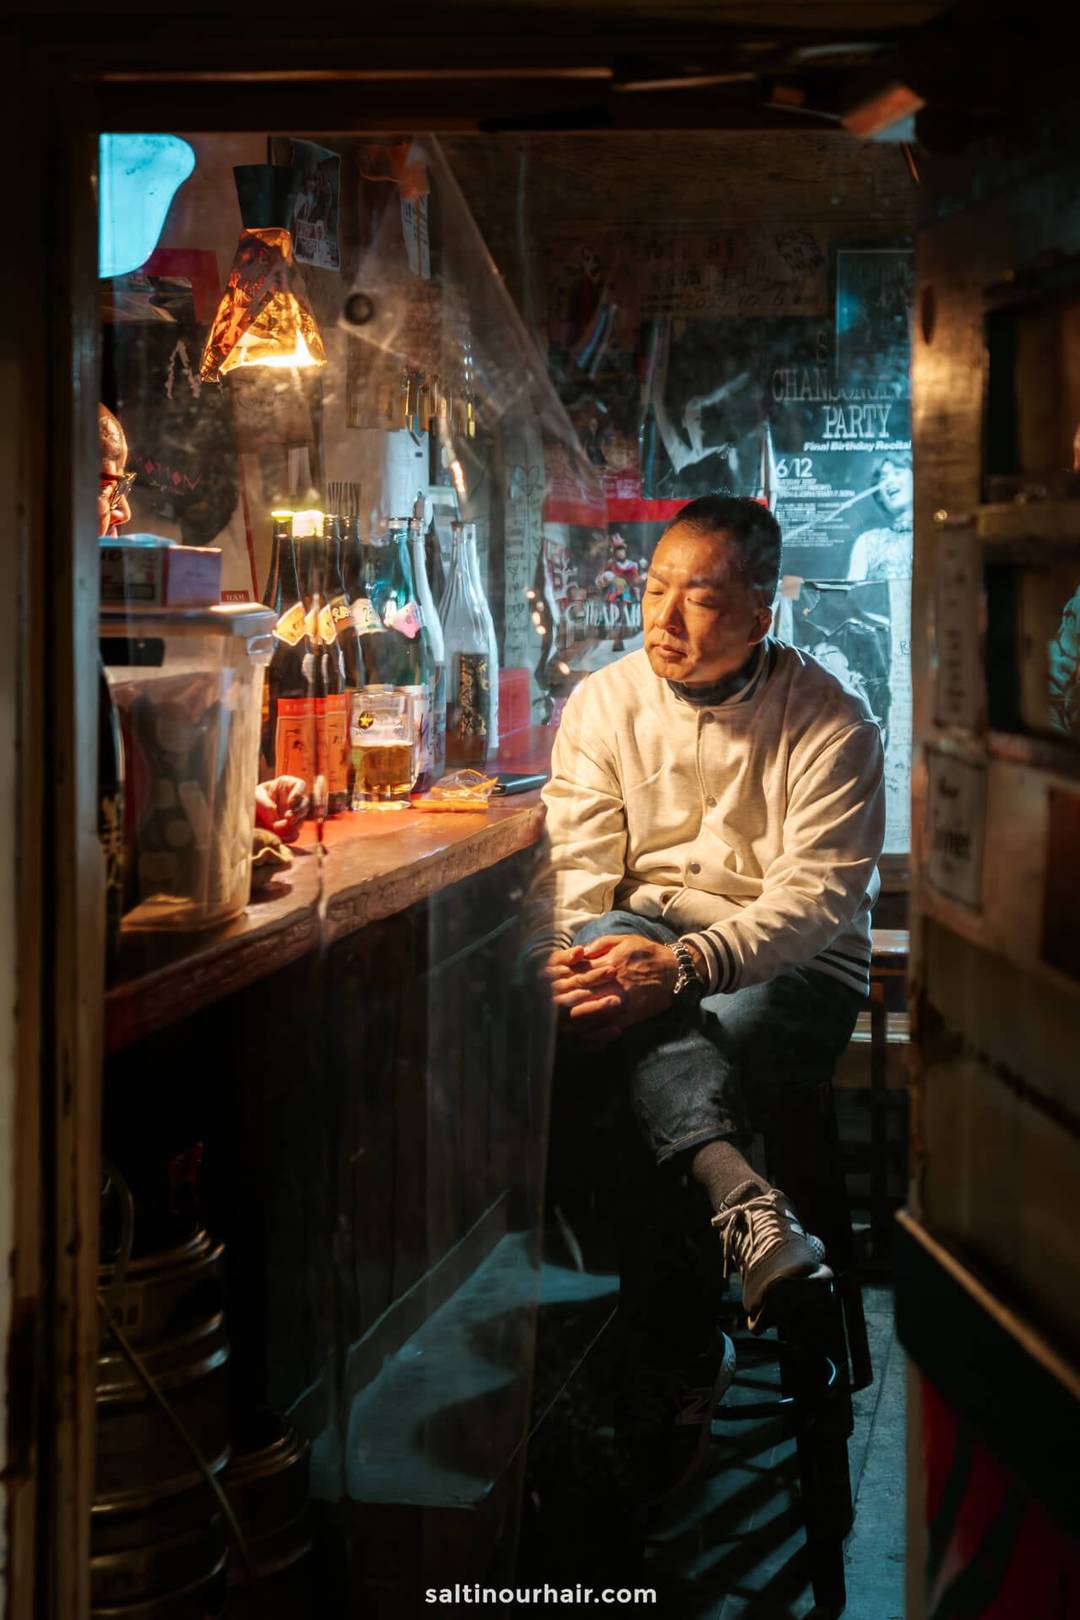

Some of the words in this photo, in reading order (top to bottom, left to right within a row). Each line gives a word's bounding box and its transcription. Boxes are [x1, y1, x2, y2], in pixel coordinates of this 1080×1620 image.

[822, 404, 892, 439] PARTY
[803, 441, 829, 452] Final
[830, 441, 875, 452] Birthday
[776, 458, 813, 478] 6/12
